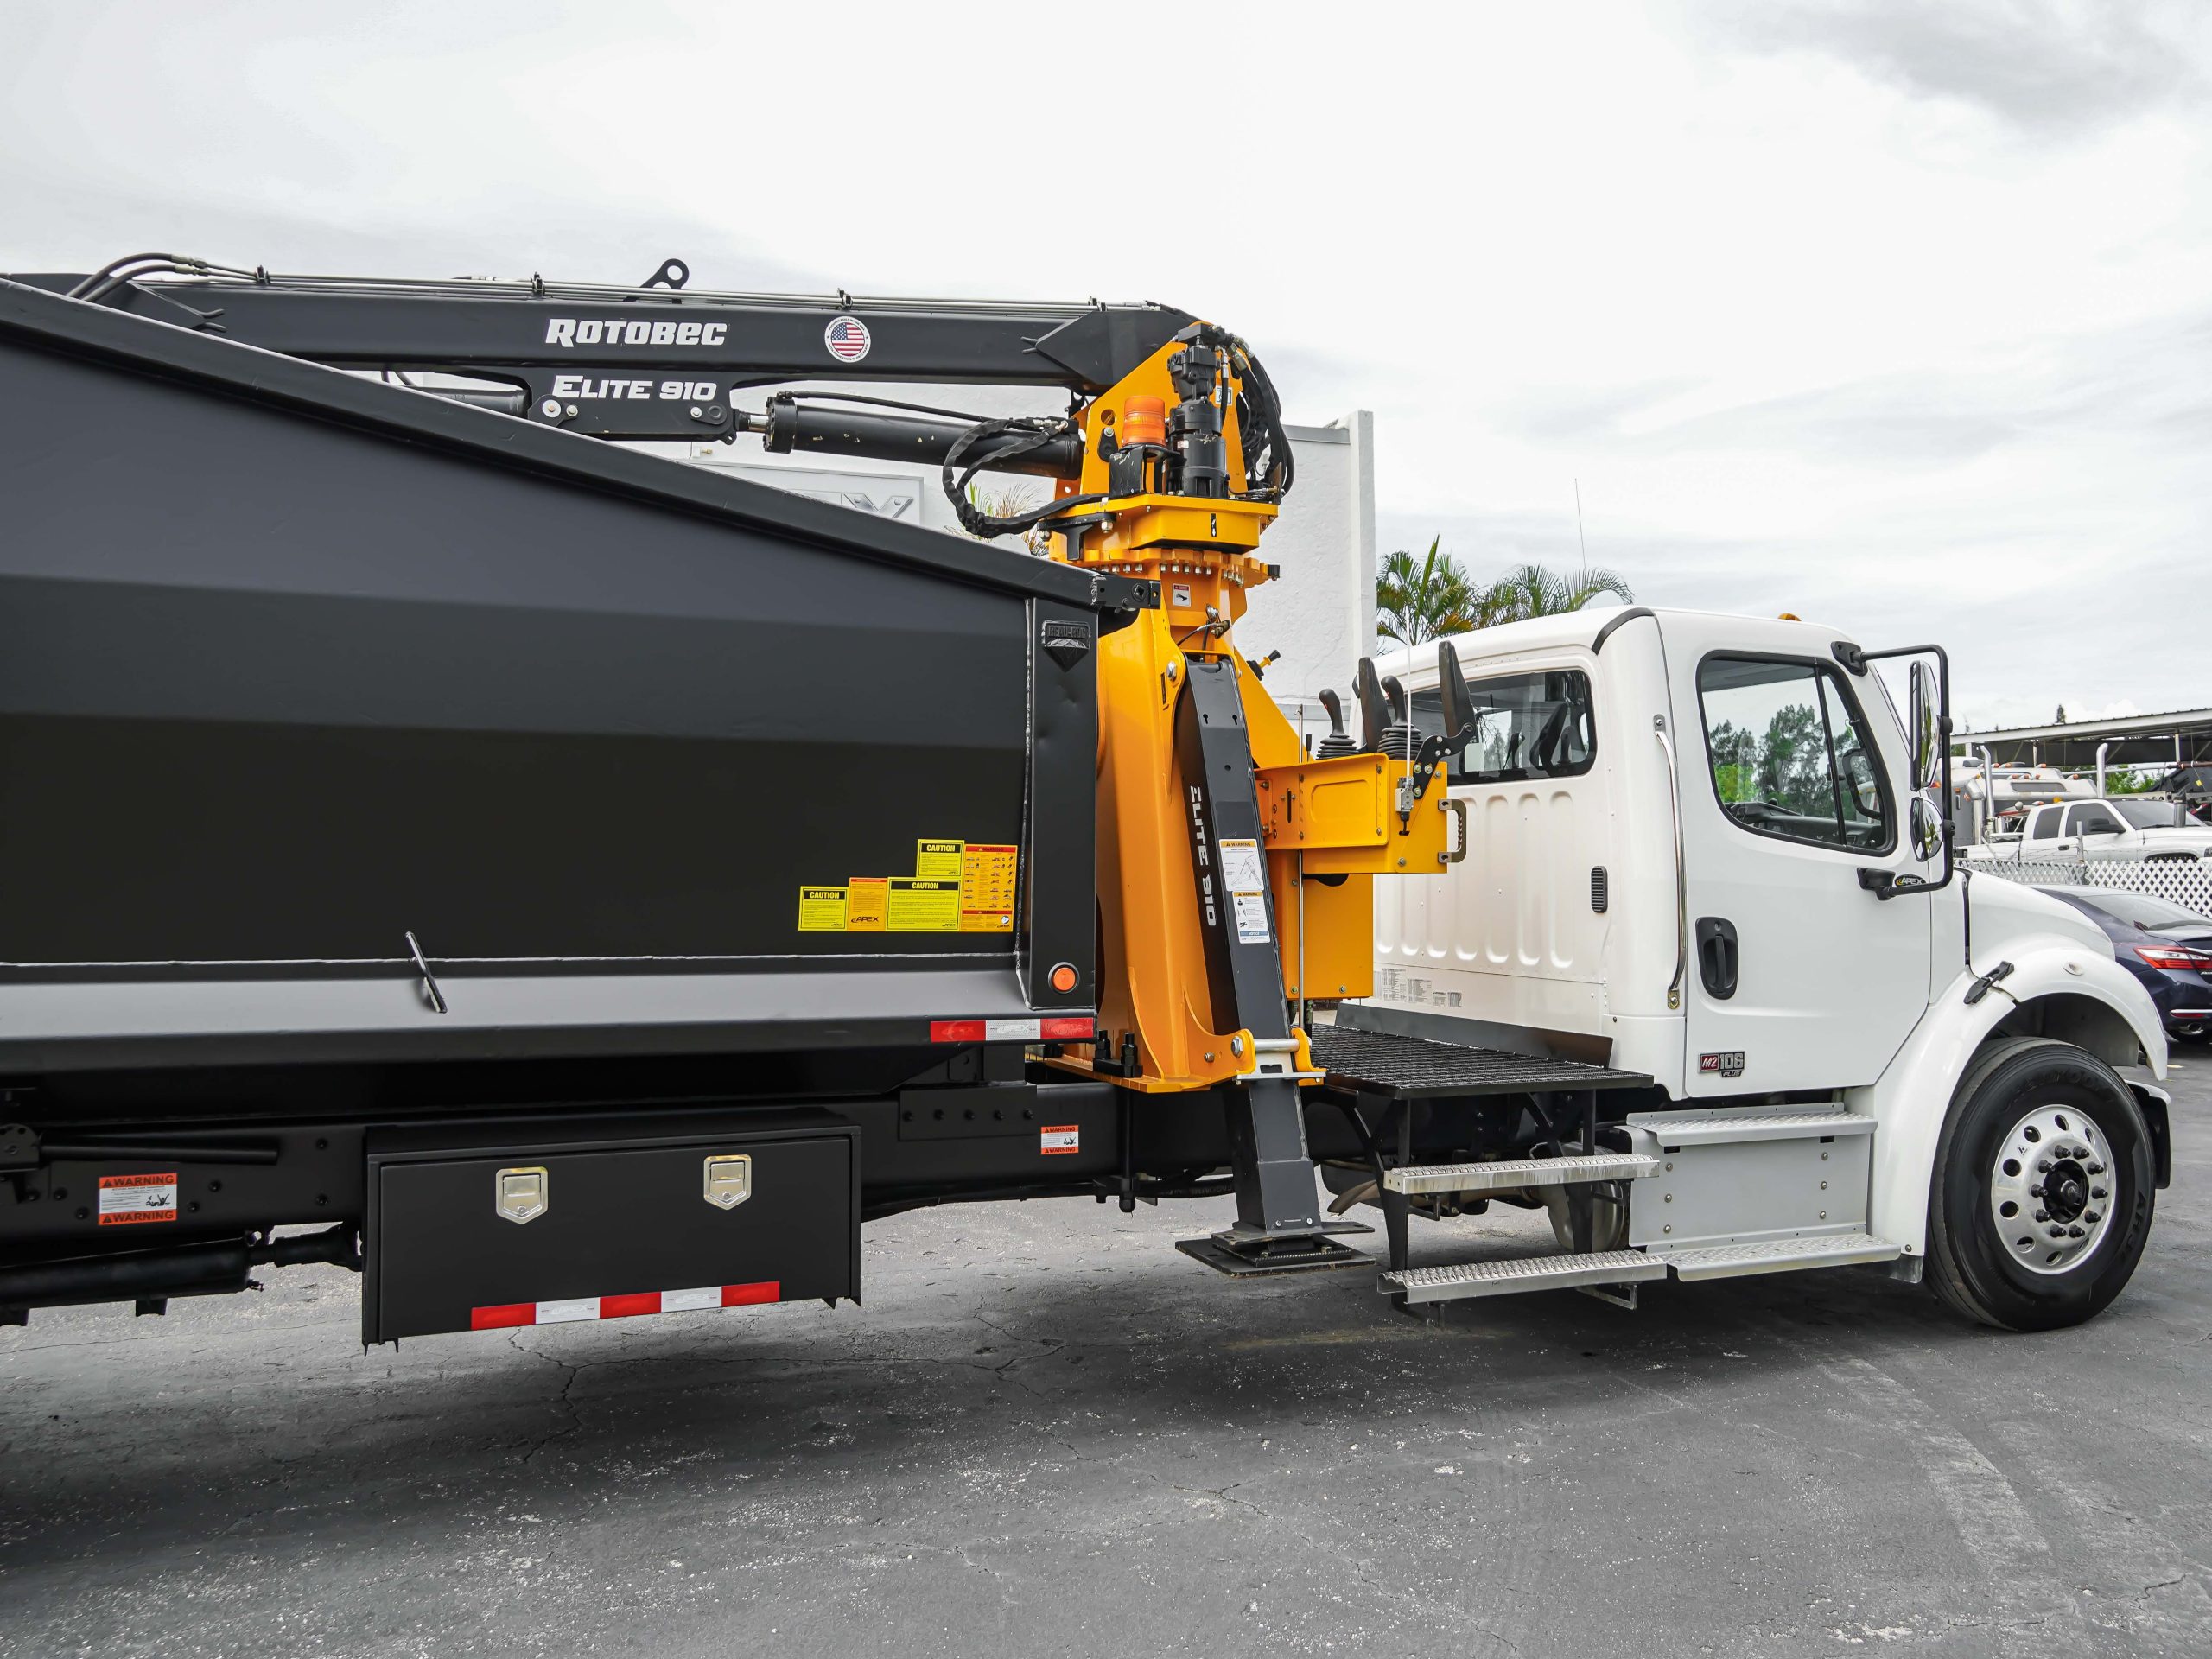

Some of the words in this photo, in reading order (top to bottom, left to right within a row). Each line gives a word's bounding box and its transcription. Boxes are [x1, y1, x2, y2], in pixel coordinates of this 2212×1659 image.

[552, 375, 653, 399] ELITE
[659, 381, 717, 401] 910
[1702, 1057, 1718, 1068] M2
[1719, 1052, 1744, 1070] 106
[113, 1175, 174, 1186] WARNING
[113, 1211, 174, 1223] WARNING
